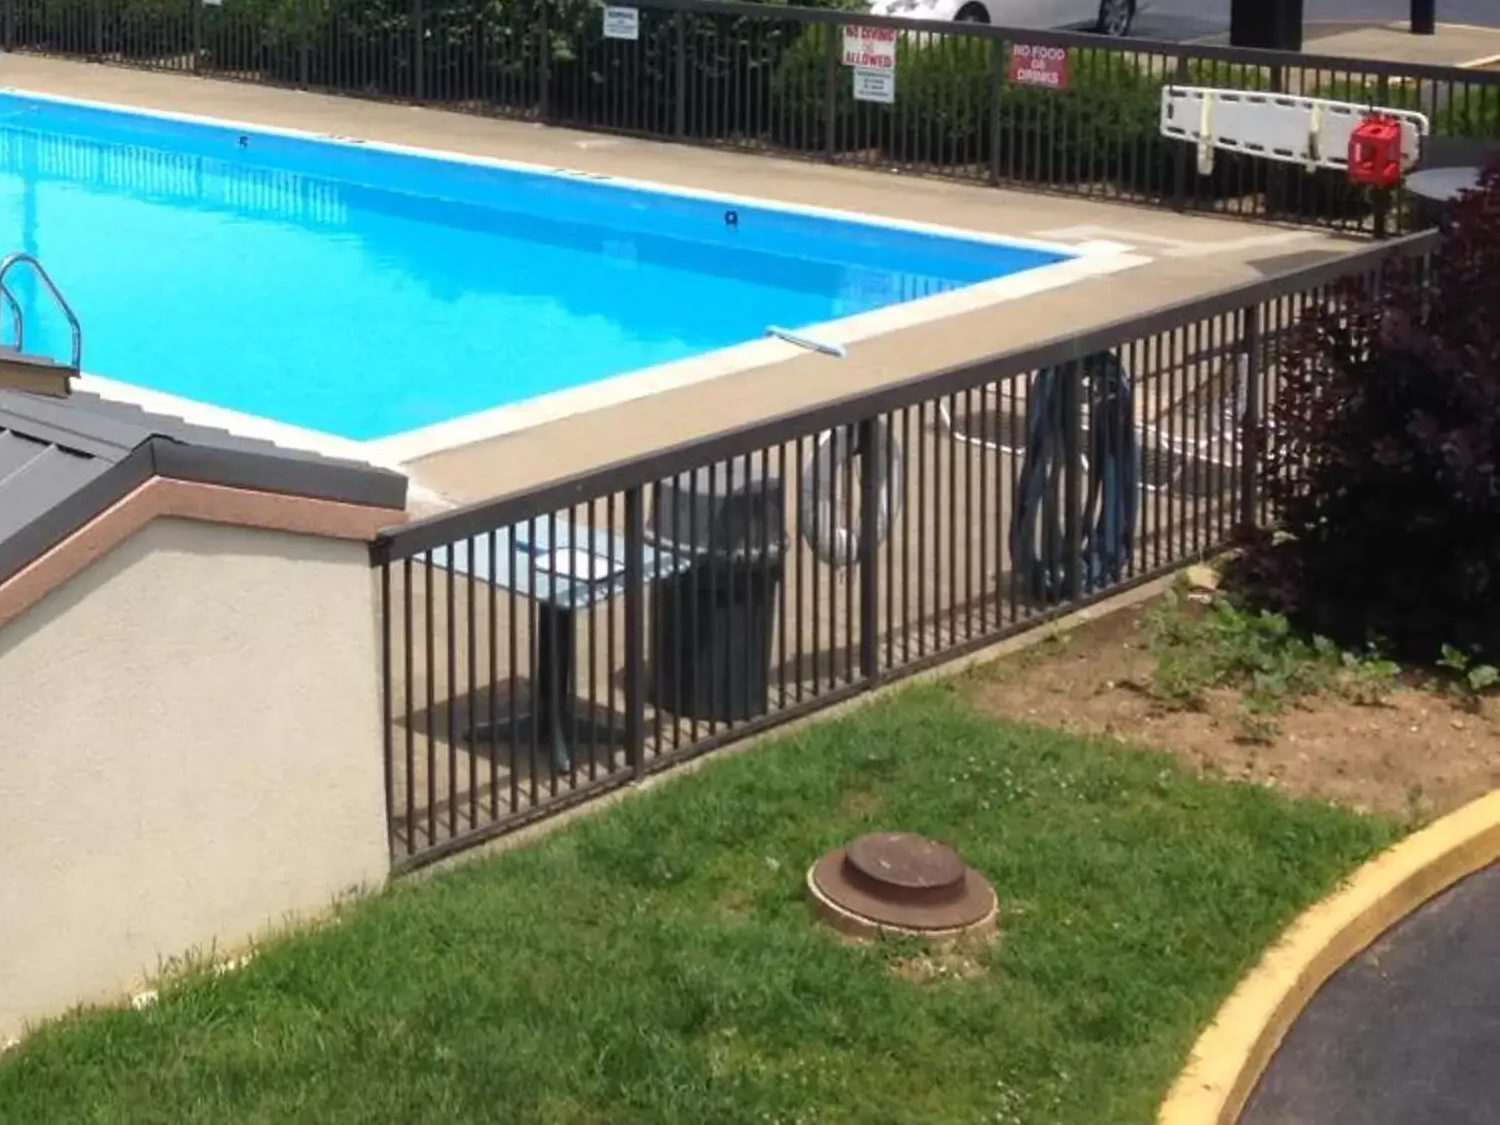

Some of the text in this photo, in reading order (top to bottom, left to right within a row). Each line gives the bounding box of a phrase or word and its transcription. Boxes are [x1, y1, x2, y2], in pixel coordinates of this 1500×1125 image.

[845, 51, 893, 68] ALLOWED
[1013, 44, 1066, 61] NO FOOD
[1016, 69, 1060, 85] DRINKS
